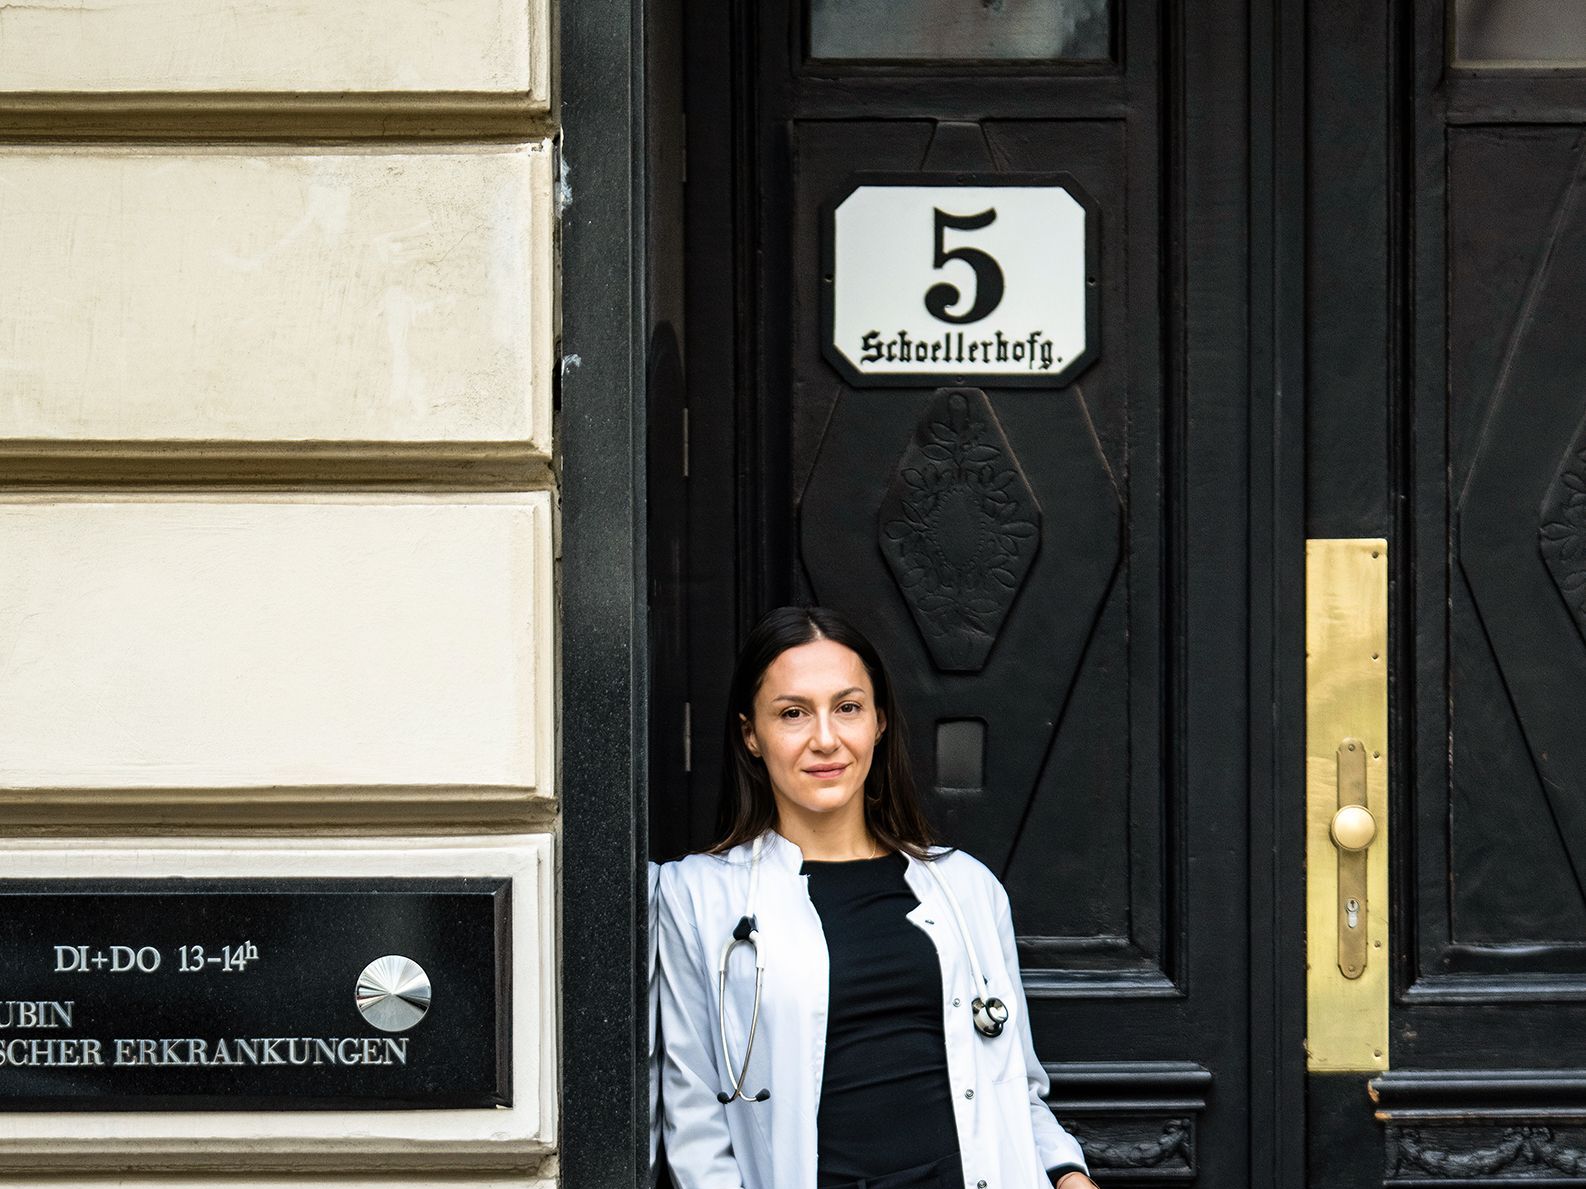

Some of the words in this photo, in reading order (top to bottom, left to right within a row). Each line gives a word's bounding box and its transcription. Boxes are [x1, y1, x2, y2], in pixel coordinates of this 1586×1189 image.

[924, 206, 1004, 325] 5
[860, 329, 1063, 370] Schoellerhofg.
[54, 945, 161, 972] DI+DO
[114, 1038, 409, 1066] ERKRANKUNGEN
